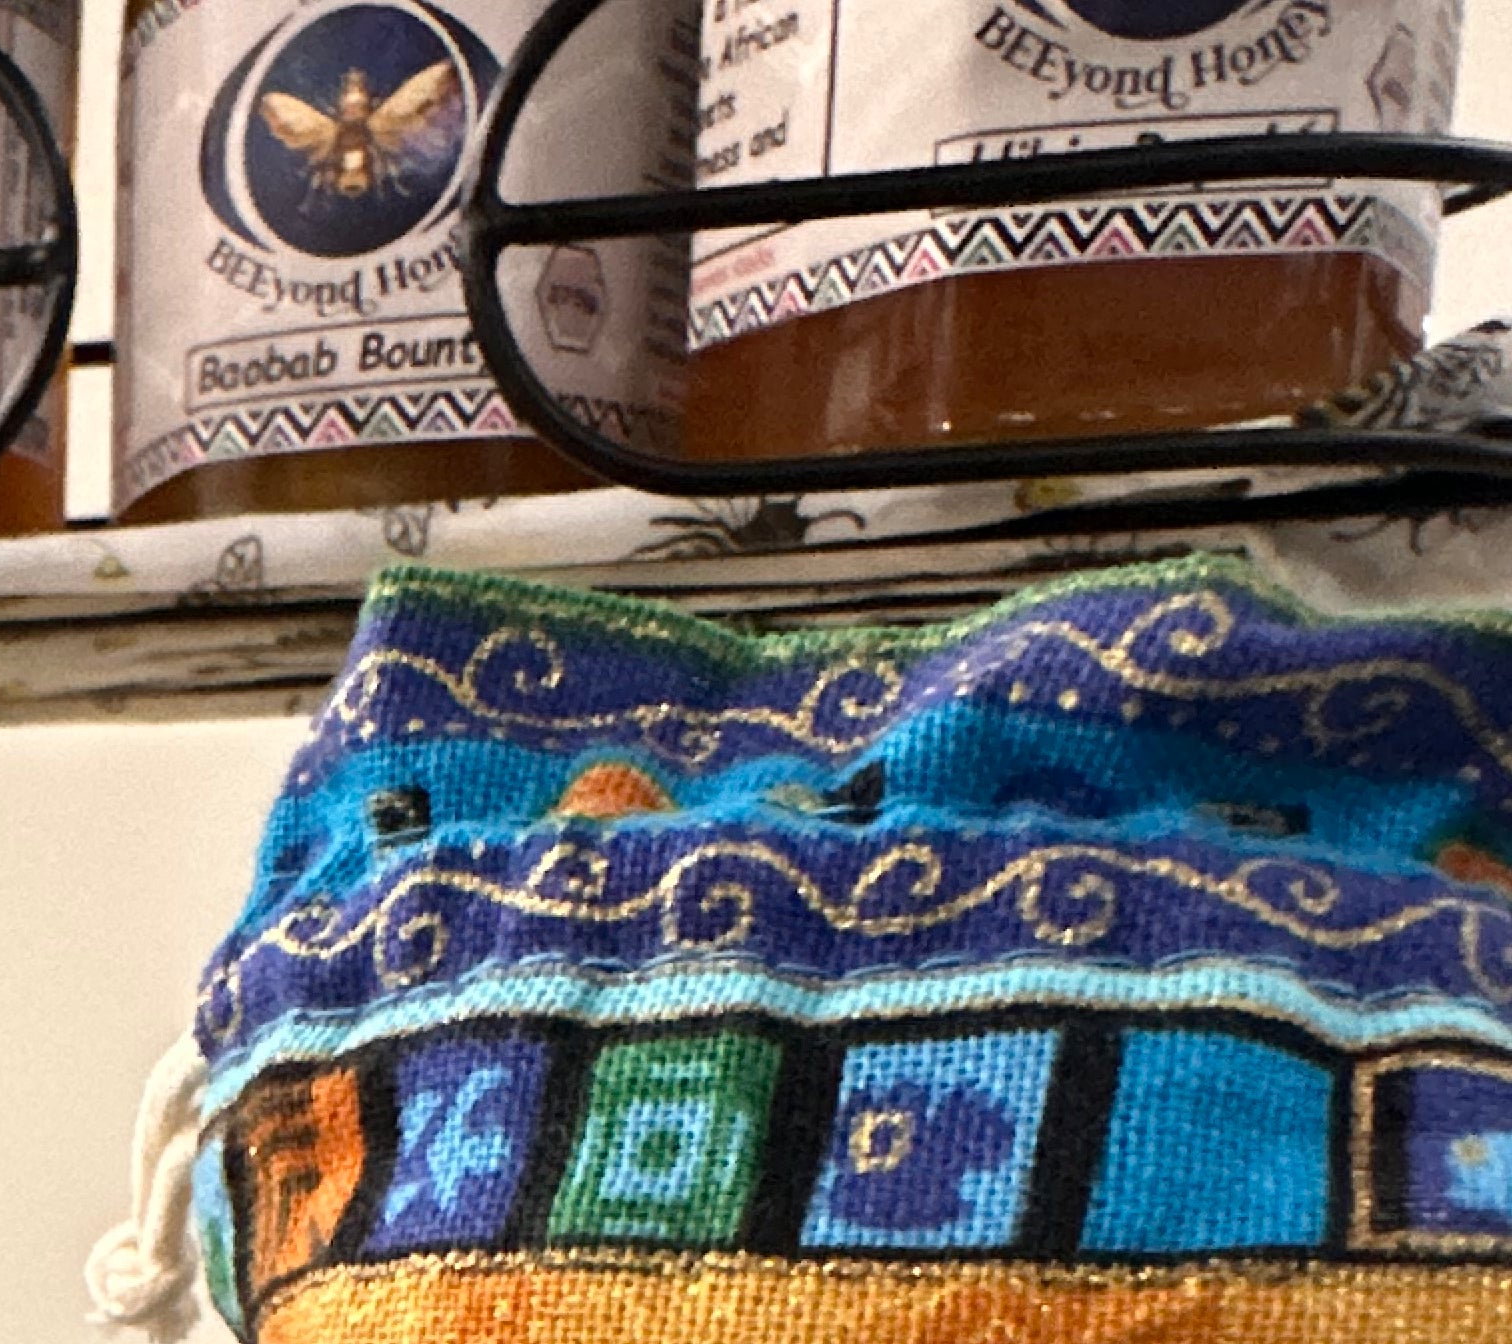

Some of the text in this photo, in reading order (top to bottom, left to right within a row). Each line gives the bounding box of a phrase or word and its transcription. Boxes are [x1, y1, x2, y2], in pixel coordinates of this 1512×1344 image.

[974, 0, 1332, 109] BEEyond Honey
[206, 237, 379, 318] BEEyond
[198, 331, 490, 394] Baobab Bount
